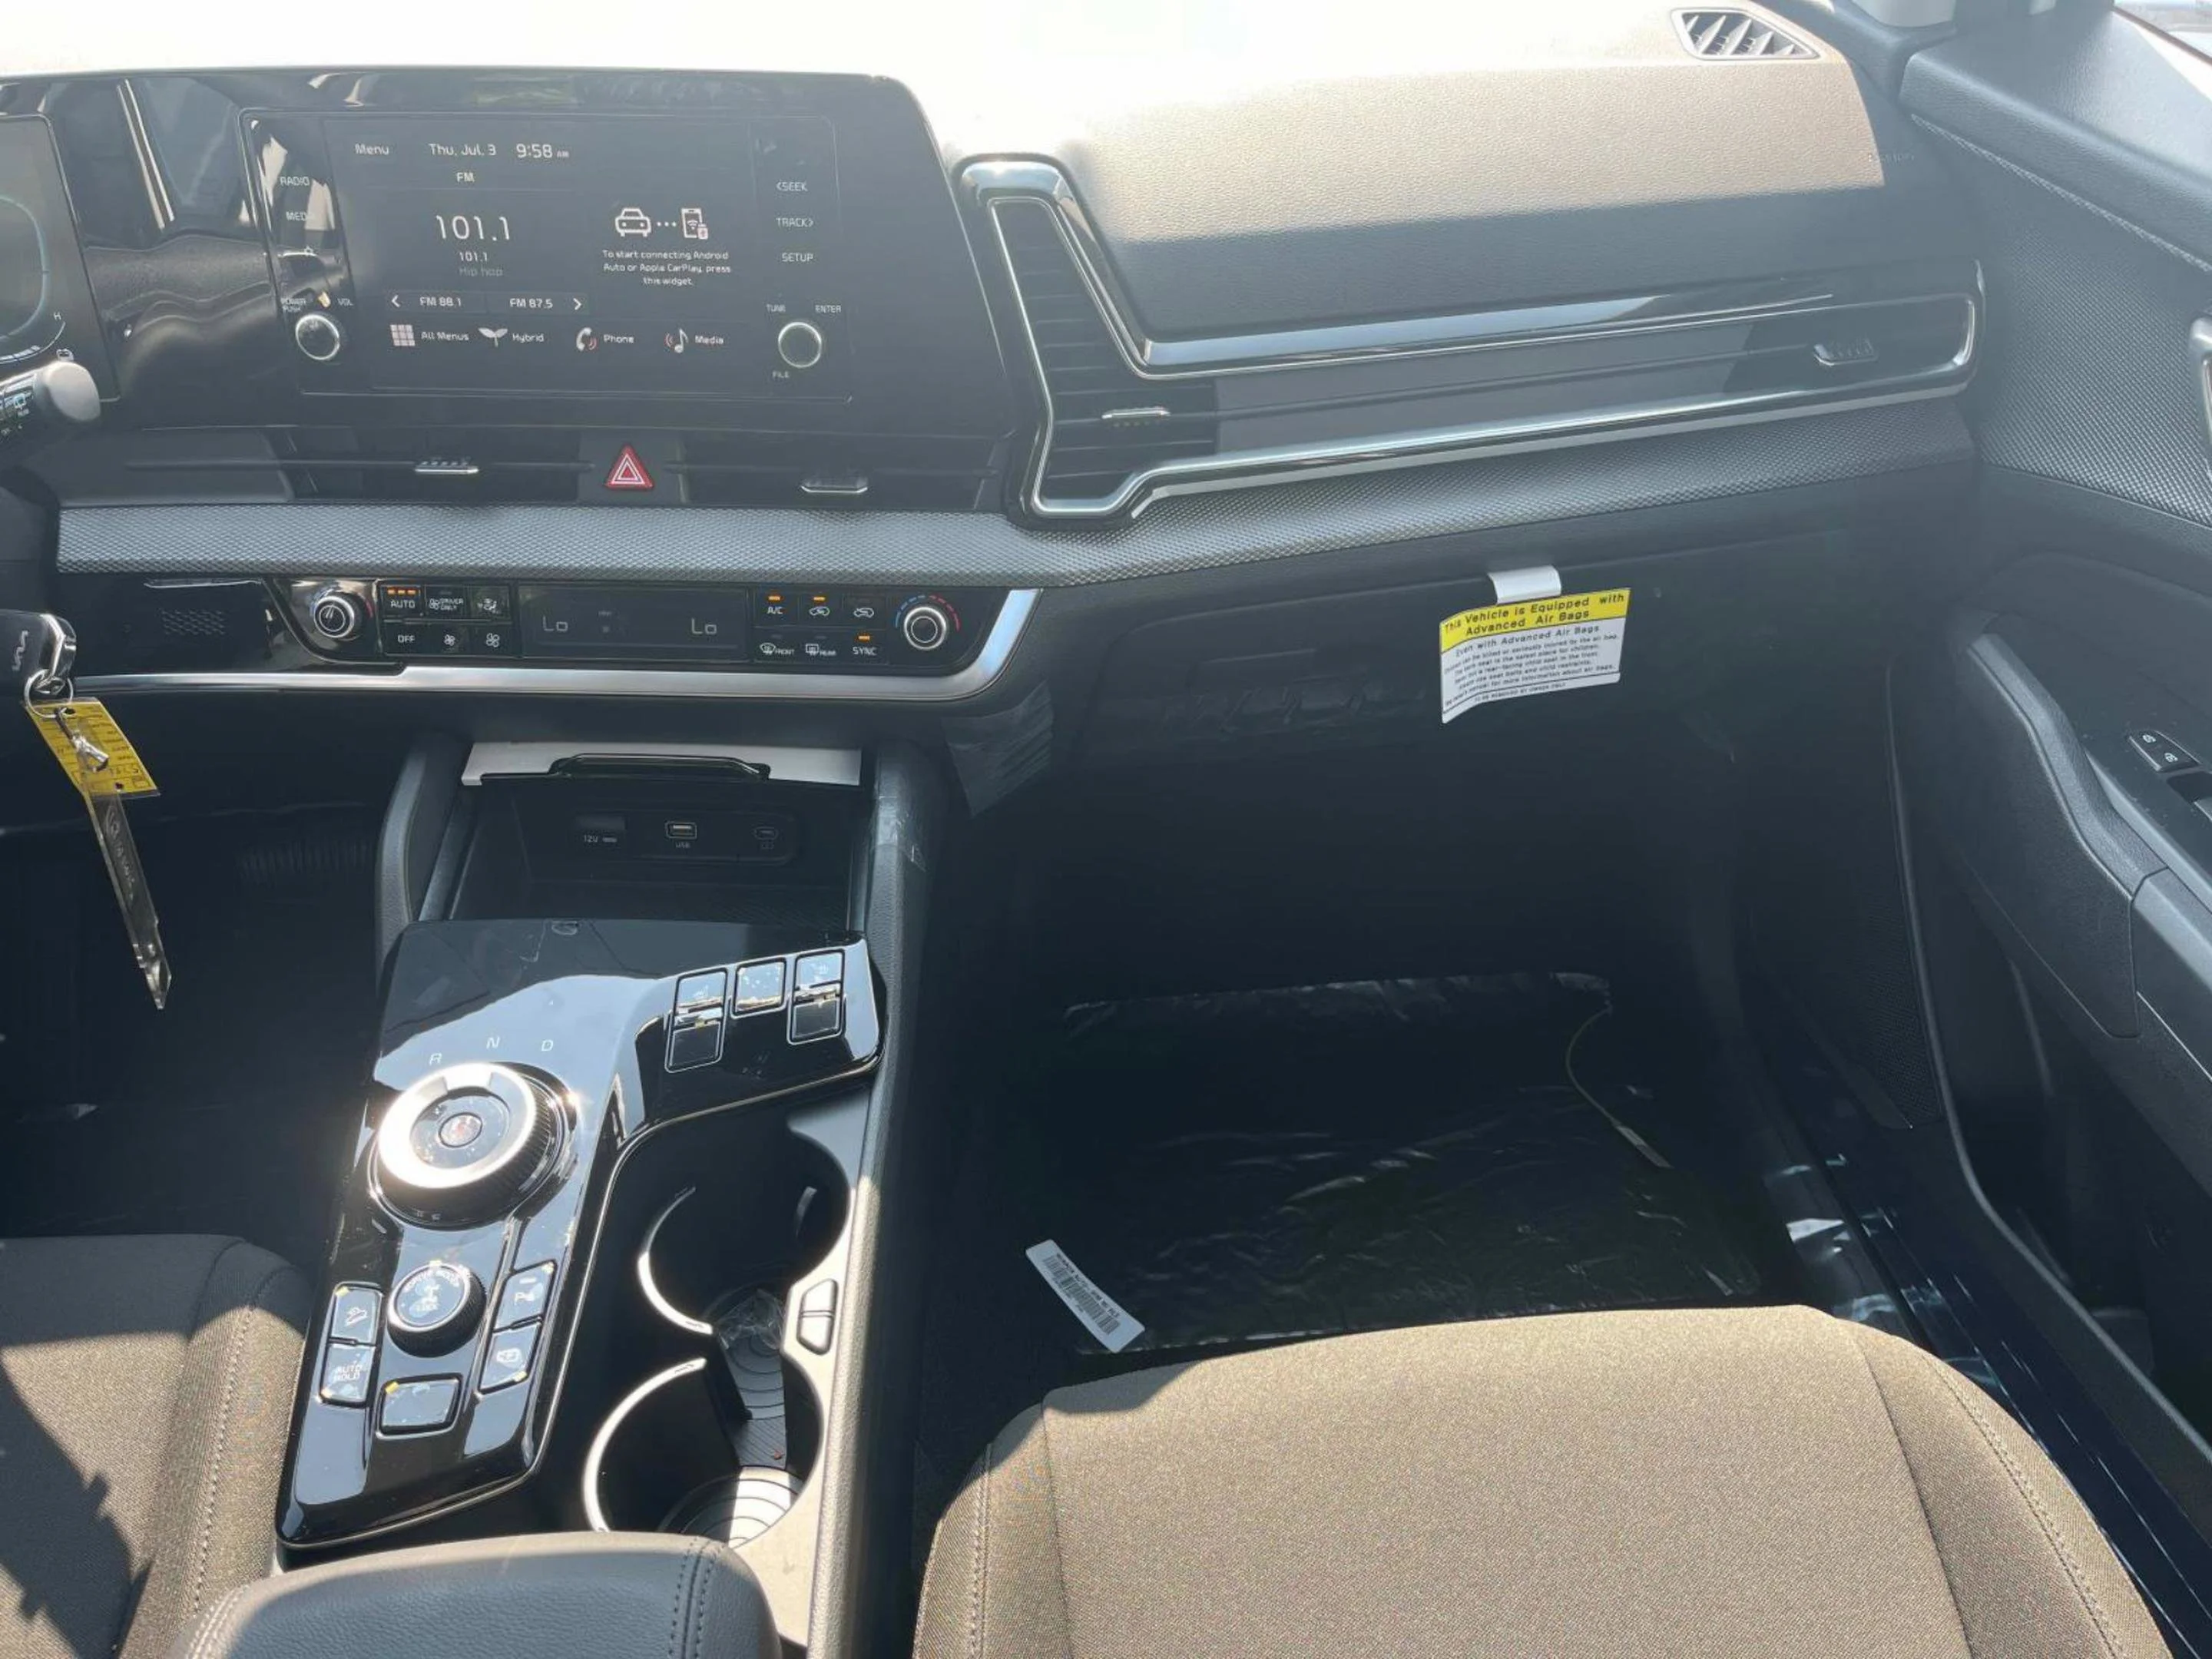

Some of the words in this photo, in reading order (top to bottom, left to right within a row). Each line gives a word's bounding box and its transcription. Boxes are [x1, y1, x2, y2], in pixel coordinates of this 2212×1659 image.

[354, 144, 389, 155] Menu
[488, 144, 496, 156] 3
[515, 144, 553, 158] 9:58
[280, 176, 310, 186] RADIO
[456, 172, 475, 183] FM
[435, 214, 510, 241] 101.1
[459, 251, 488, 262] 101.1
[602, 250, 614, 259] To
[616, 250, 638, 259] start
[641, 251, 691, 260] connecting
[694, 251, 729, 260] Android
[782, 253, 814, 263] SETUP
[603, 263, 626, 272] Auto
[640, 263, 665, 273] Apple
[706, 266, 731, 274] press
[643, 276, 661, 285] this
[419, 296, 436, 306] FM
[439, 297, 462, 307] 88.1
[509, 298, 527, 308] FM
[528, 299, 553, 309] 87.5
[815, 304, 842, 313] ENTER
[421, 332, 435, 340] All
[437, 332, 469, 341] Menus
[512, 333, 545, 343] Hybrid
[603, 334, 634, 344] Phone
[694, 335, 724, 345] Media
[390, 600, 416, 608] AUTO
[1465, 609, 1509, 624] Vehicle
[1515, 607, 1525, 615] is
[1531, 597, 1590, 613] Equipped
[1599, 593, 1624, 604] with
[767, 606, 783, 614] A/C
[542, 616, 568, 632] Lo
[690, 618, 717, 635] Lo
[1466, 618, 1526, 636] Advanced
[1535, 614, 1554, 624] Air
[1559, 611, 1589, 622] Bags
[397, 634, 415, 643] OFF
[1477, 639, 1497, 649] with
[1501, 631, 1551, 644] Advanced
[1555, 628, 1570, 637] Air
[1575, 625, 1599, 635] Bags
[853, 646, 878, 656] SYNC
[486, 1036, 501, 1050] N
[541, 1039, 554, 1052] D
[429, 1052, 442, 1065] R
